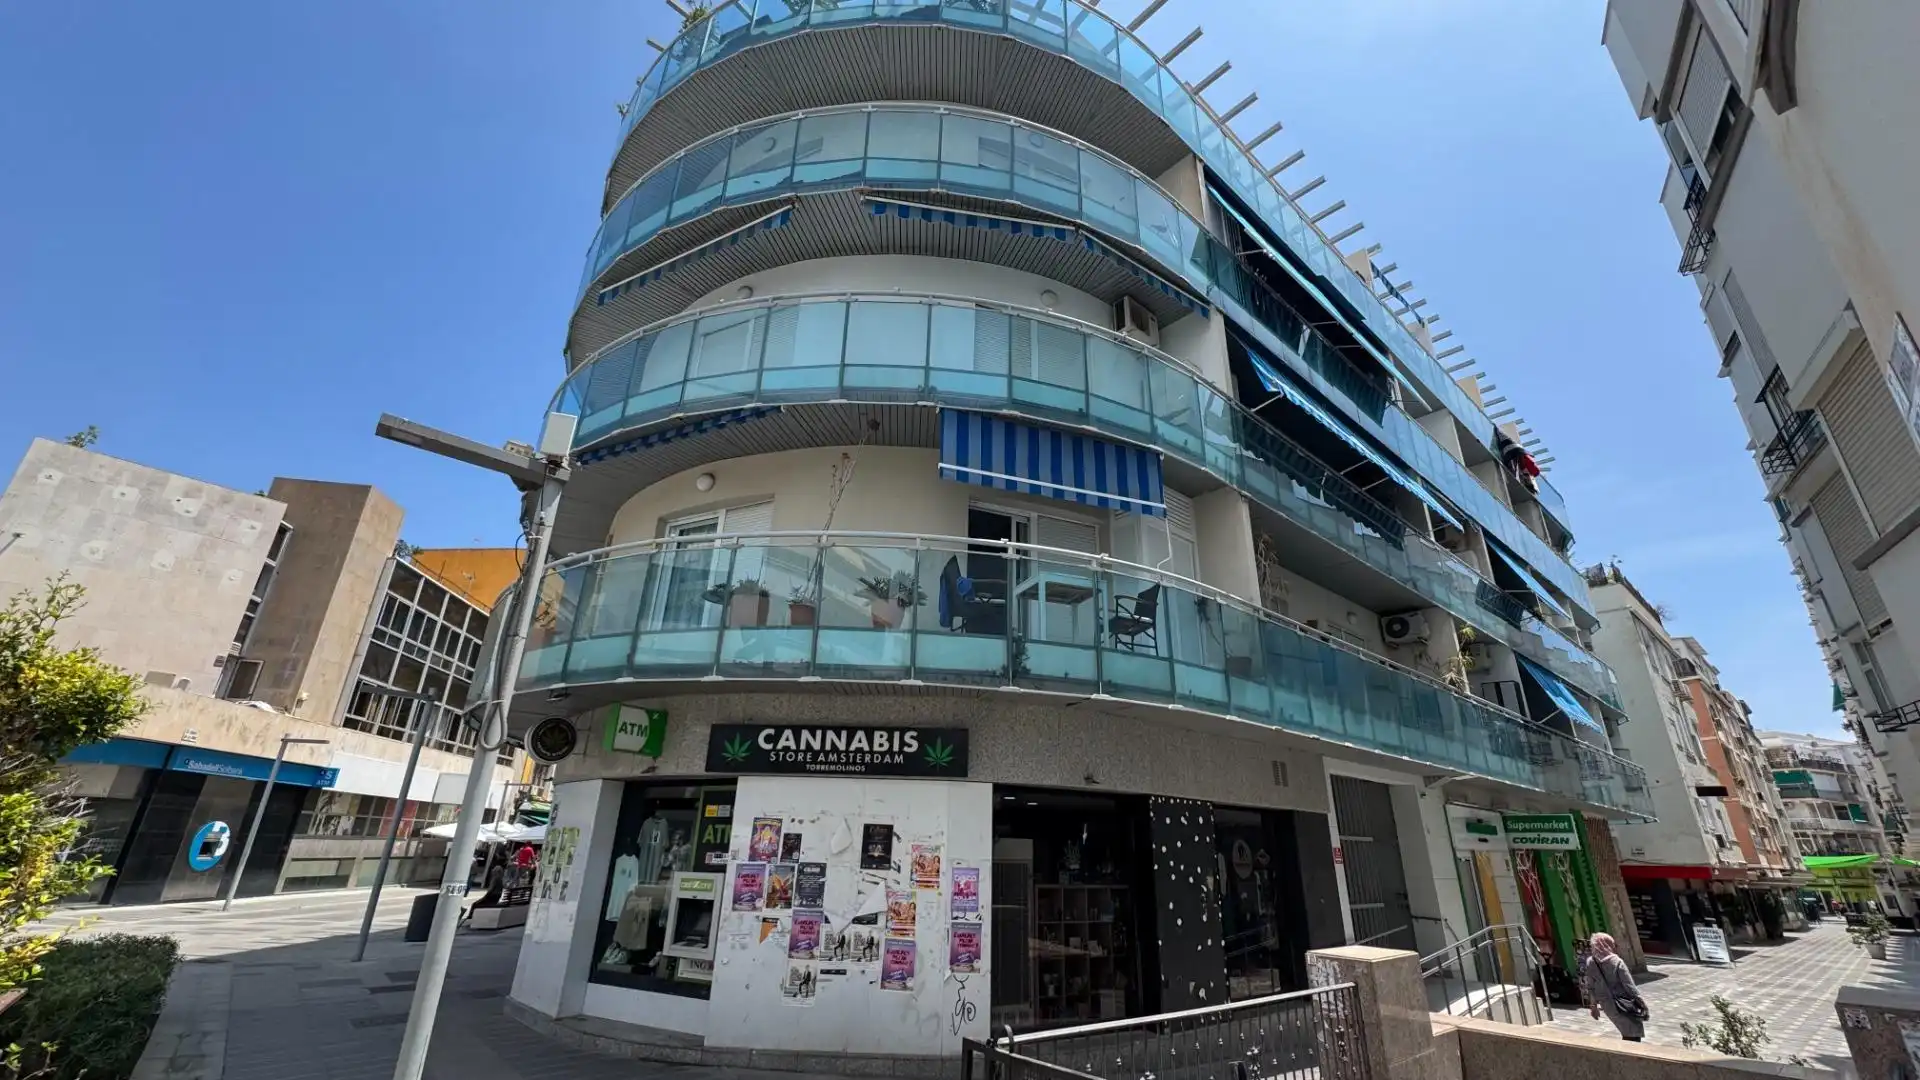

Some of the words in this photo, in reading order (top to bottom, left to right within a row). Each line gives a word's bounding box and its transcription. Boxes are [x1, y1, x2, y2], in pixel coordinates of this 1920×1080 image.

[618, 721, 648, 737] ATM
[757, 728, 919, 752] CANNABIS
[769, 751, 812, 762] STORE
[818, 752, 904, 764] AMSTERDAM
[806, 764, 866, 772] TORREMOLINOS
[1507, 820, 1569, 831] Supermarket
